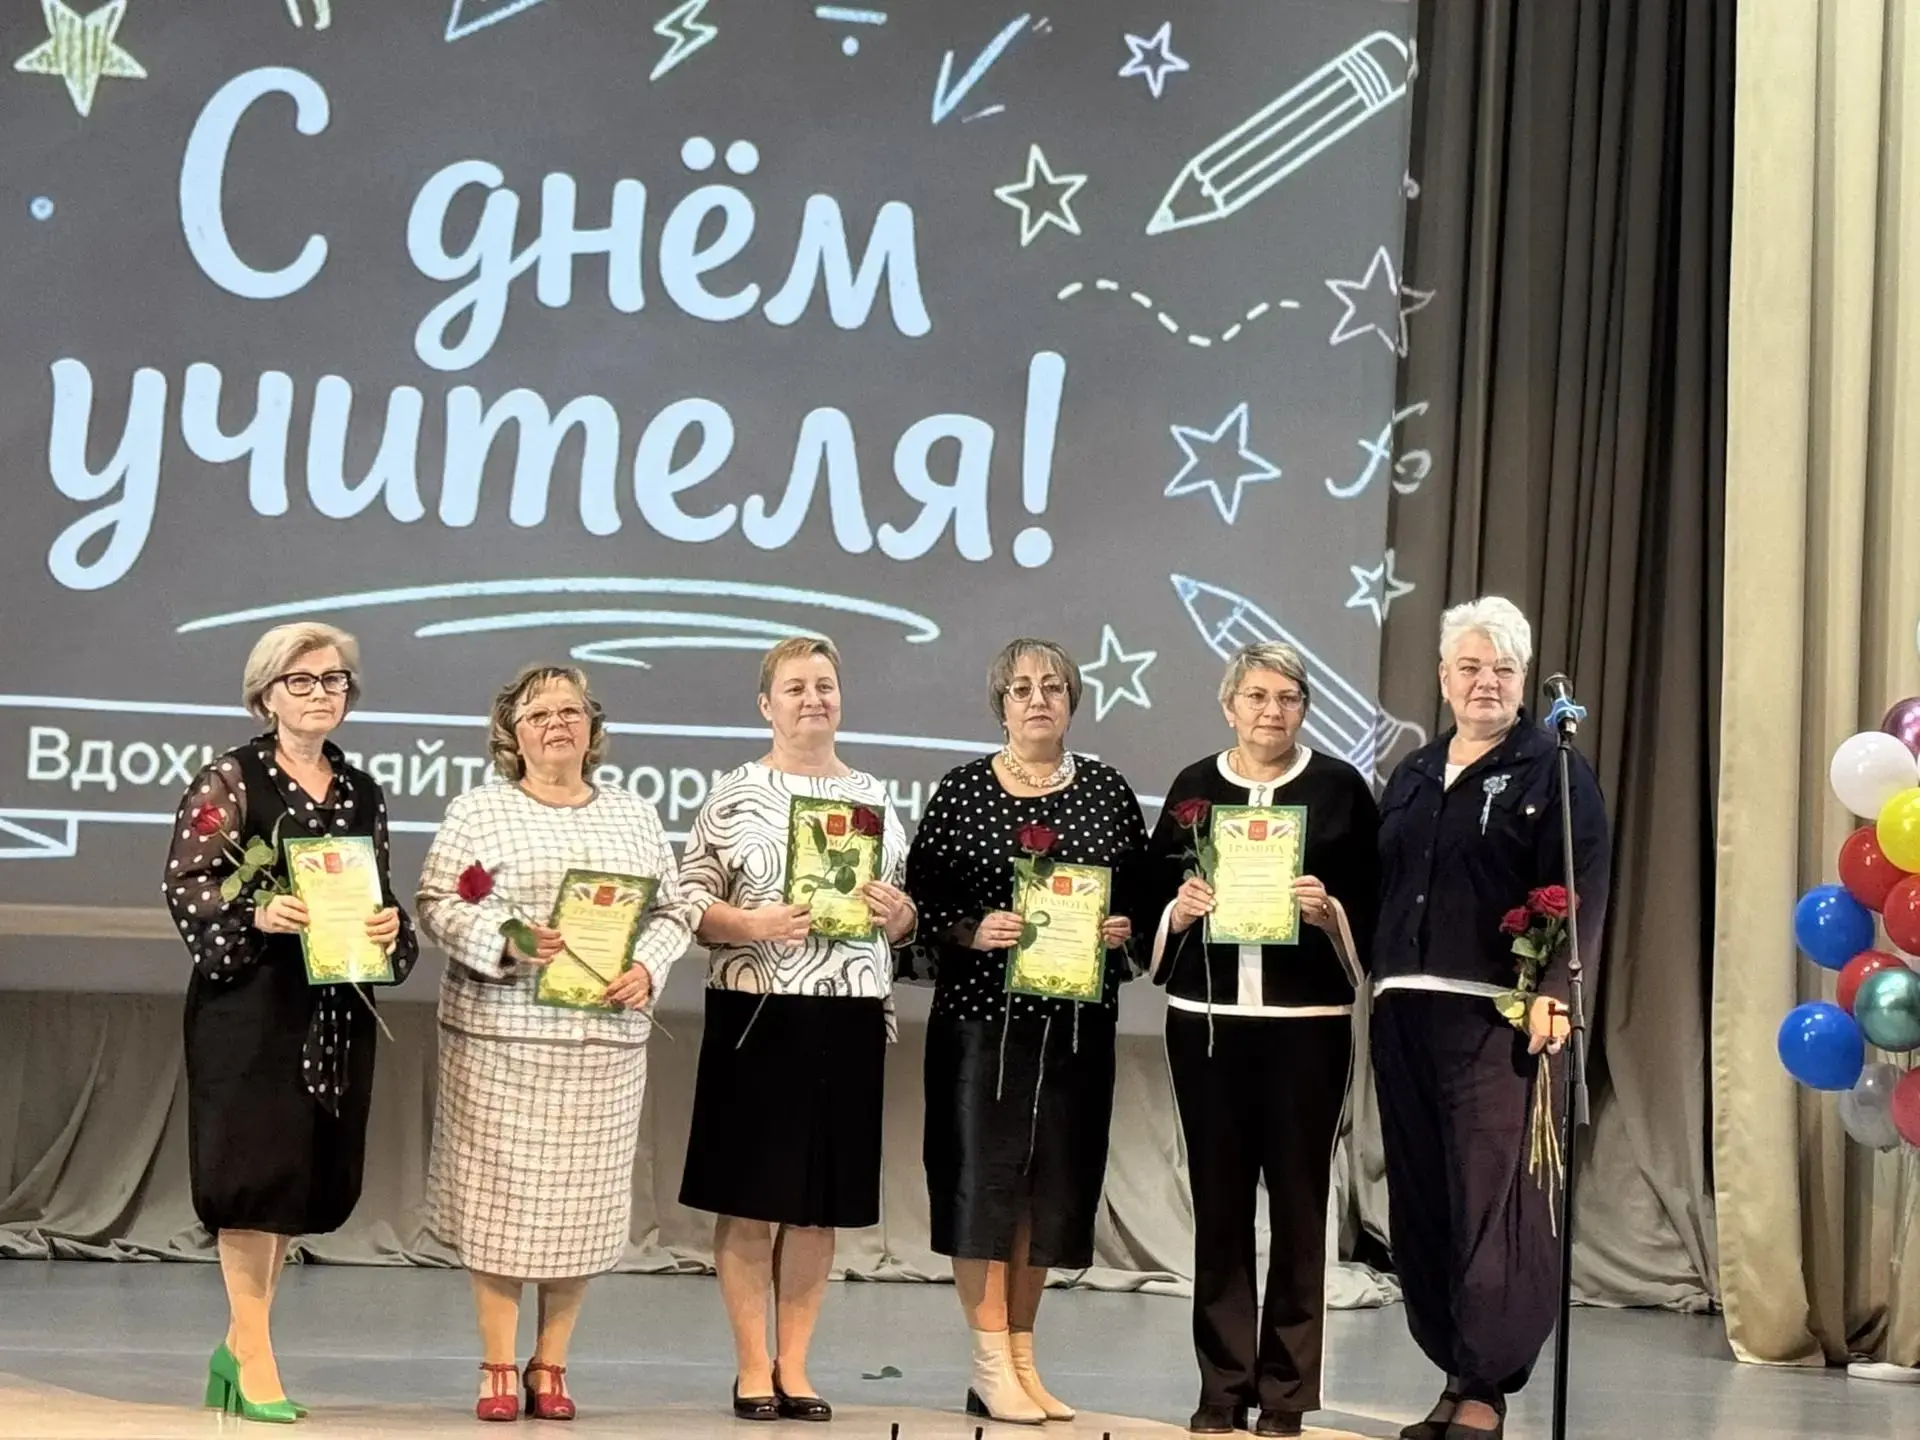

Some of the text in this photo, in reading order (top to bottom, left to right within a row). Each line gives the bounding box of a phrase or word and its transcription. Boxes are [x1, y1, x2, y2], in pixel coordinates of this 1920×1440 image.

[180, 66, 932, 371] С днём
[47, 351, 1067, 591] учителя!
